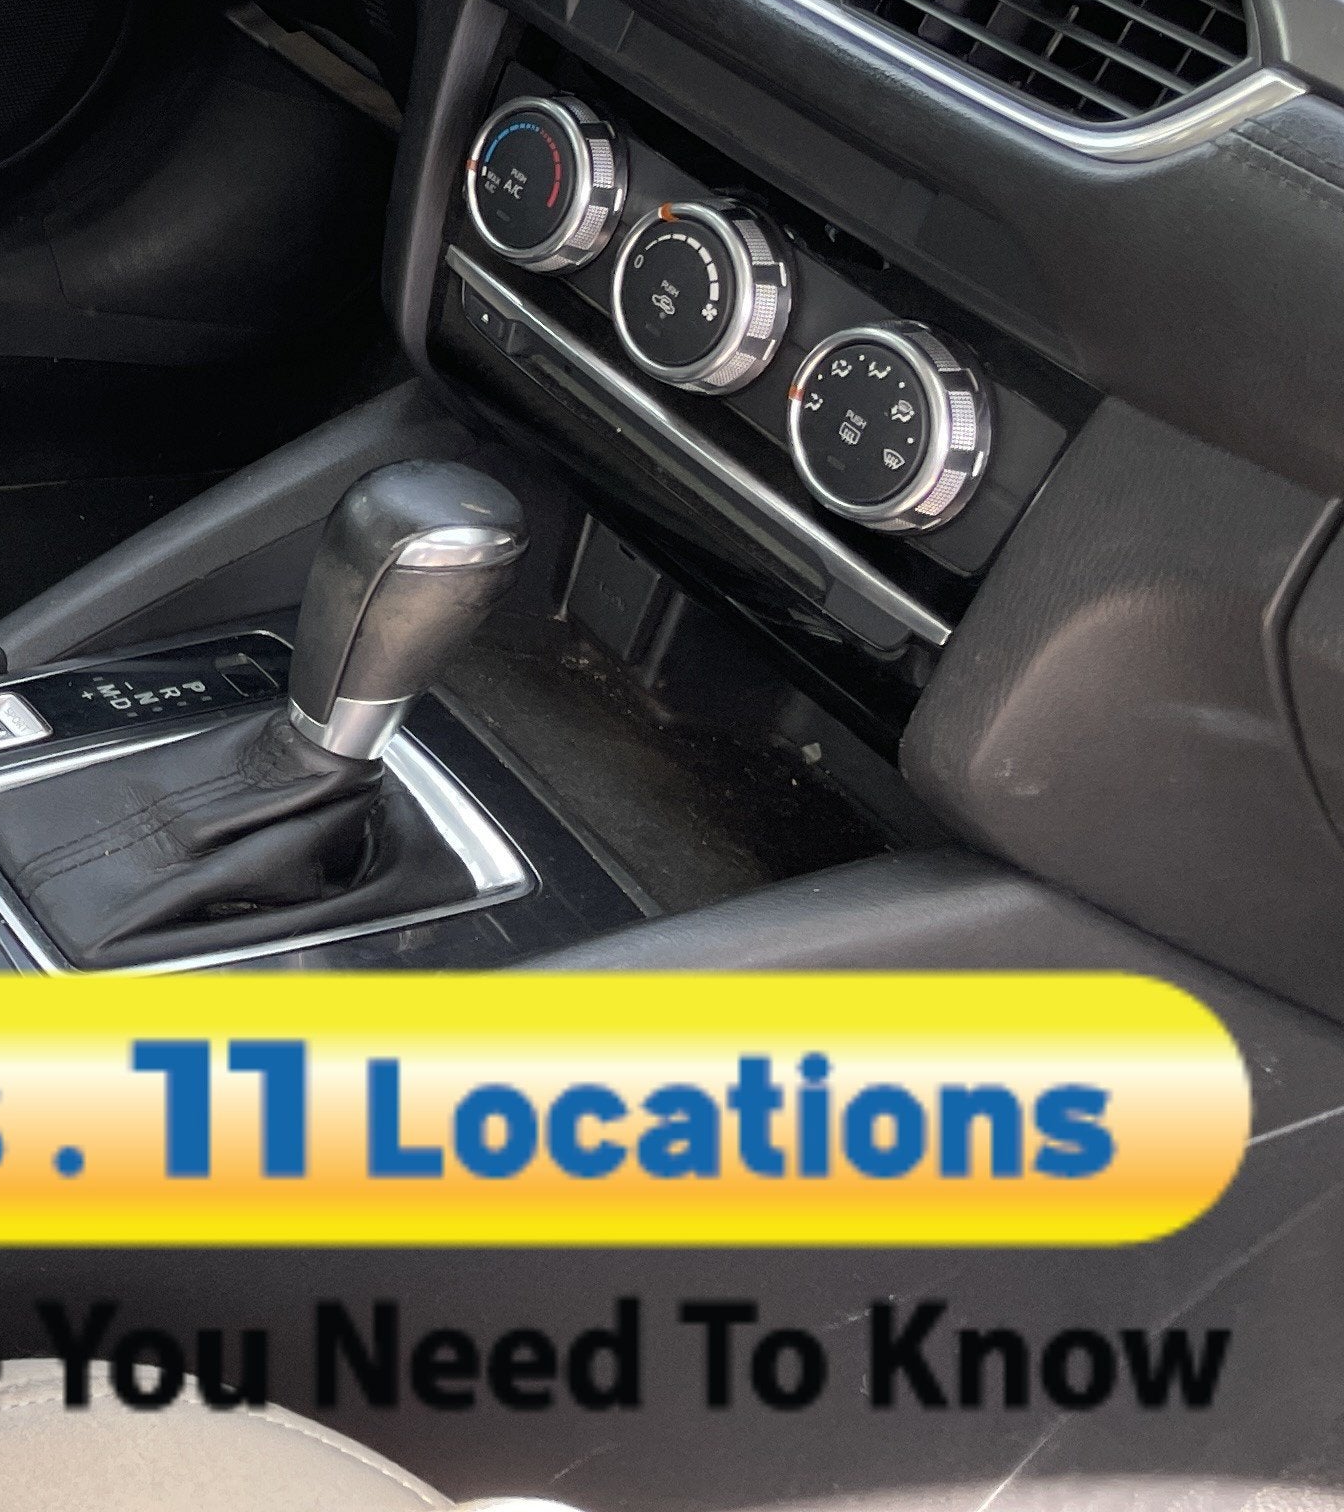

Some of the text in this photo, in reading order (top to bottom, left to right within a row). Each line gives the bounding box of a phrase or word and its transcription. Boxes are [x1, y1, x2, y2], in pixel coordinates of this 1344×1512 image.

[502, 179, 524, 200] A/C
[660, 279, 681, 299] PUSH
[845, 409, 868, 430] PUSH
[158, 686, 182, 699] R
[181, 681, 206, 693] P
[109, 697, 132, 710] D
[133, 690, 160, 706] N
[4, 707, 32, 732] SPORT
